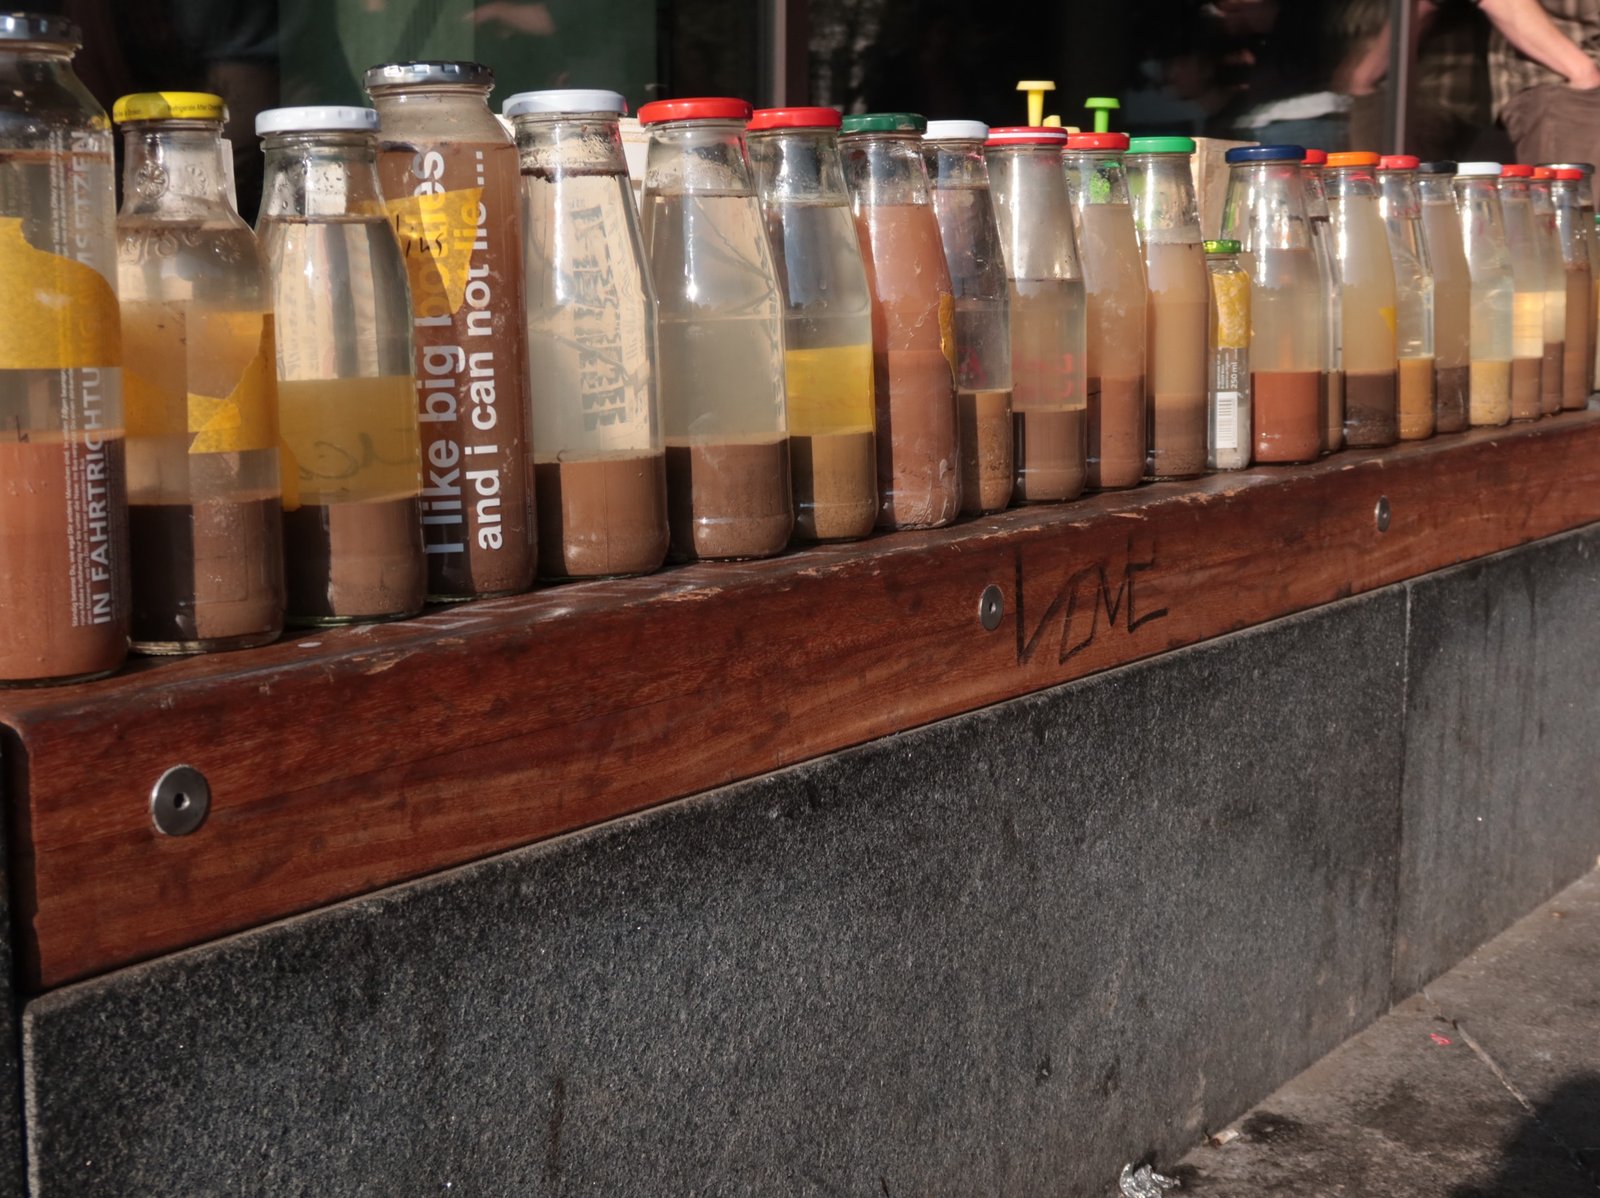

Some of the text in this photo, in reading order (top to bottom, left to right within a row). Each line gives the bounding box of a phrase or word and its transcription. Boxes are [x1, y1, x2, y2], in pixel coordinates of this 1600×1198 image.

[412, 151, 452, 327] bottles
[453, 201, 488, 250] lie
[457, 263, 493, 337] not
[416, 345, 466, 422] big
[468, 352, 498, 431] can
[1230, 361, 1238, 373] ml
[1230, 374, 1238, 389] 250
[464, 444, 498, 455] i
[65, 467, 73, 499] Menschen
[422, 439, 463, 524] like
[466, 469, 503, 550] and
[424, 543, 464, 553] I
[93, 592, 111, 624] IN
